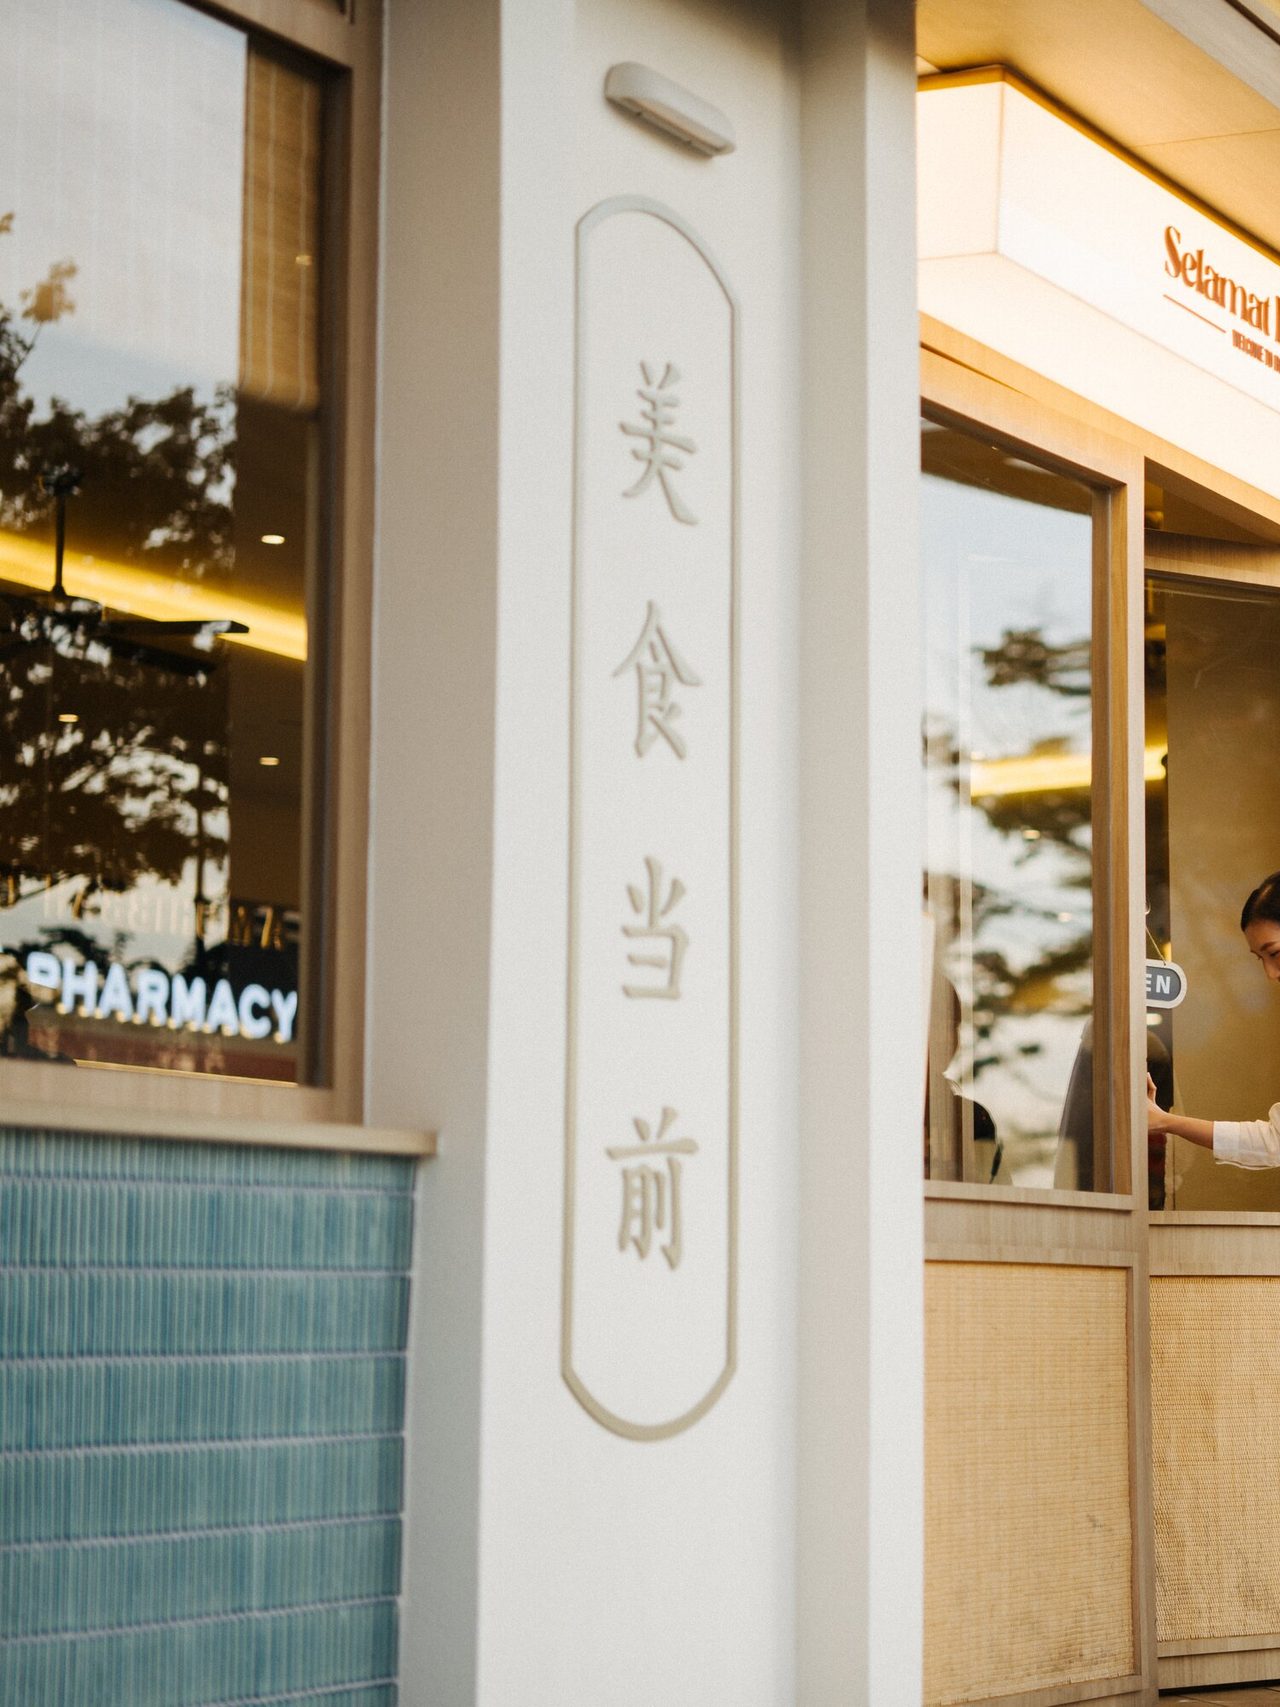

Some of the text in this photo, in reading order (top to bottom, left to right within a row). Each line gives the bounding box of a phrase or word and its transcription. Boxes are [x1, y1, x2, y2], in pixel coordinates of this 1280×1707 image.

[1164, 225, 1270, 336] Selamat
[606, 360, 703, 1270] 美食当前
[27, 951, 298, 1044] PHARMACY
